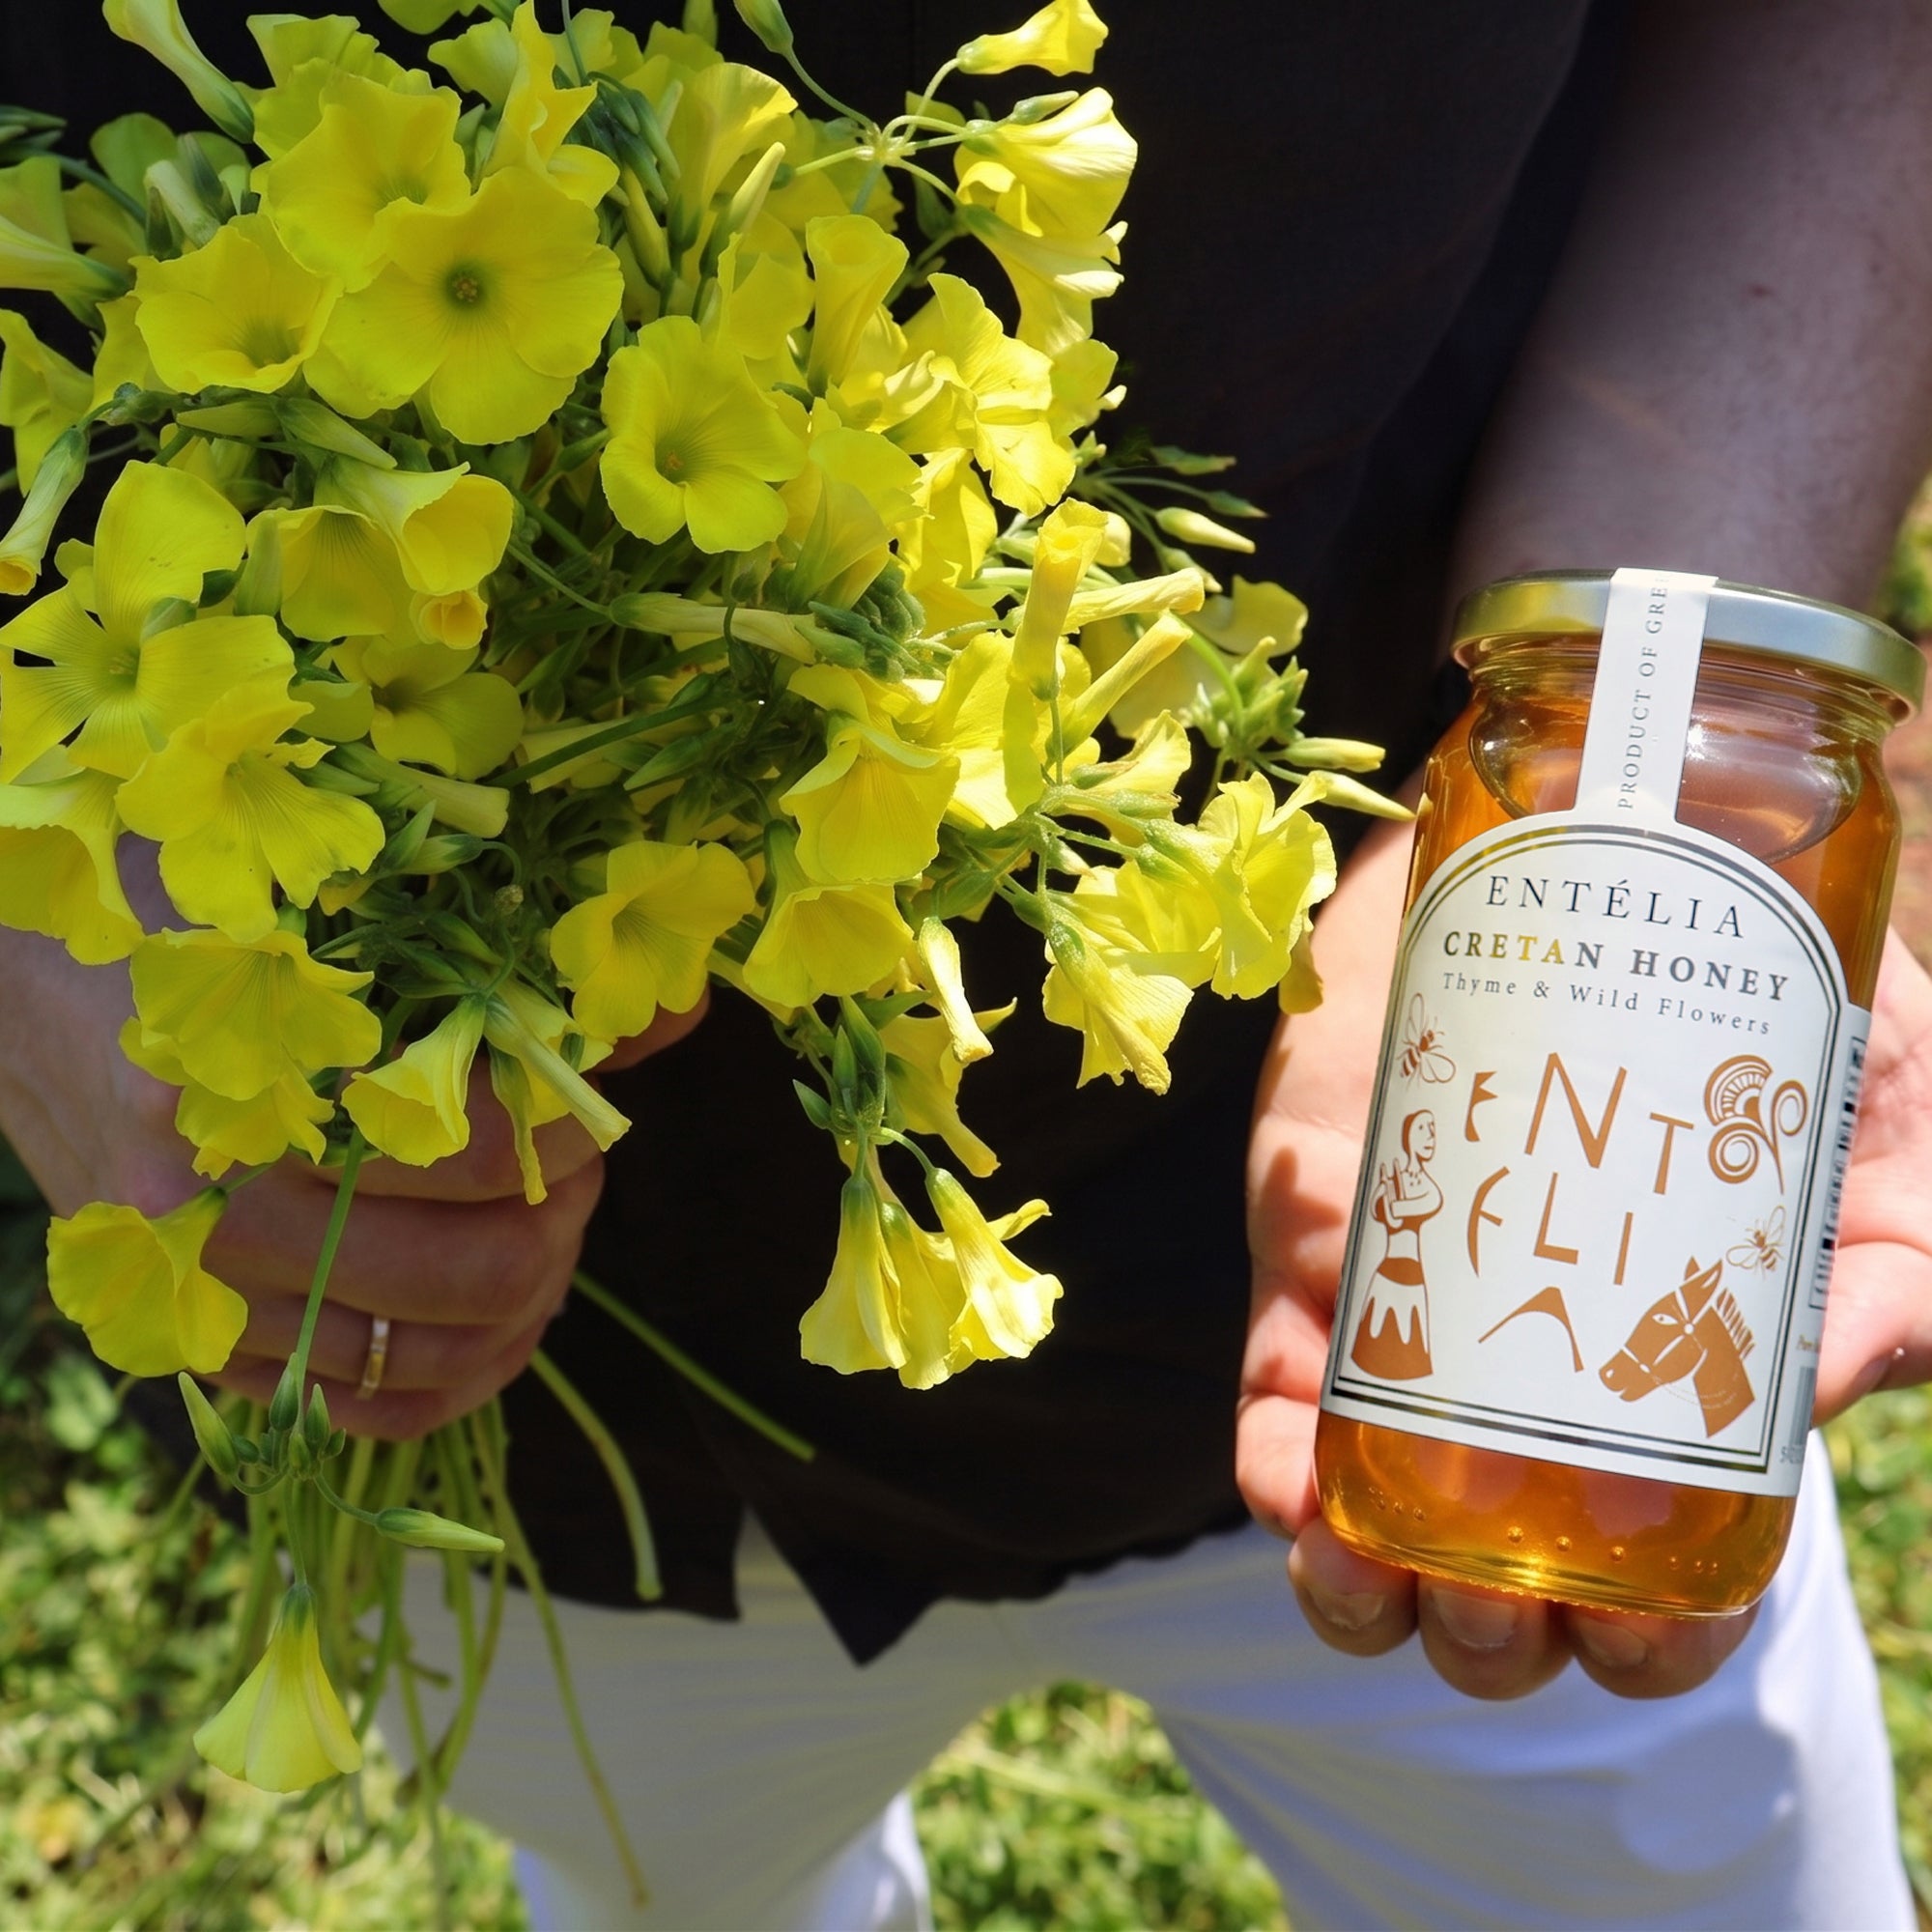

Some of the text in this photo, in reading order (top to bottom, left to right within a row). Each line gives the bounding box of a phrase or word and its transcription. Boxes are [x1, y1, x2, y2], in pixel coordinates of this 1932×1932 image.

[1616, 689, 1653, 810] PRODUCT
[1638, 646, 1659, 677] OF
[1486, 875, 1744, 939] ENTÉLIA
[1443, 930, 1789, 1001] CRETAN HONEY
[1443, 972, 1771, 1035] Thyme & Wild Flowers
